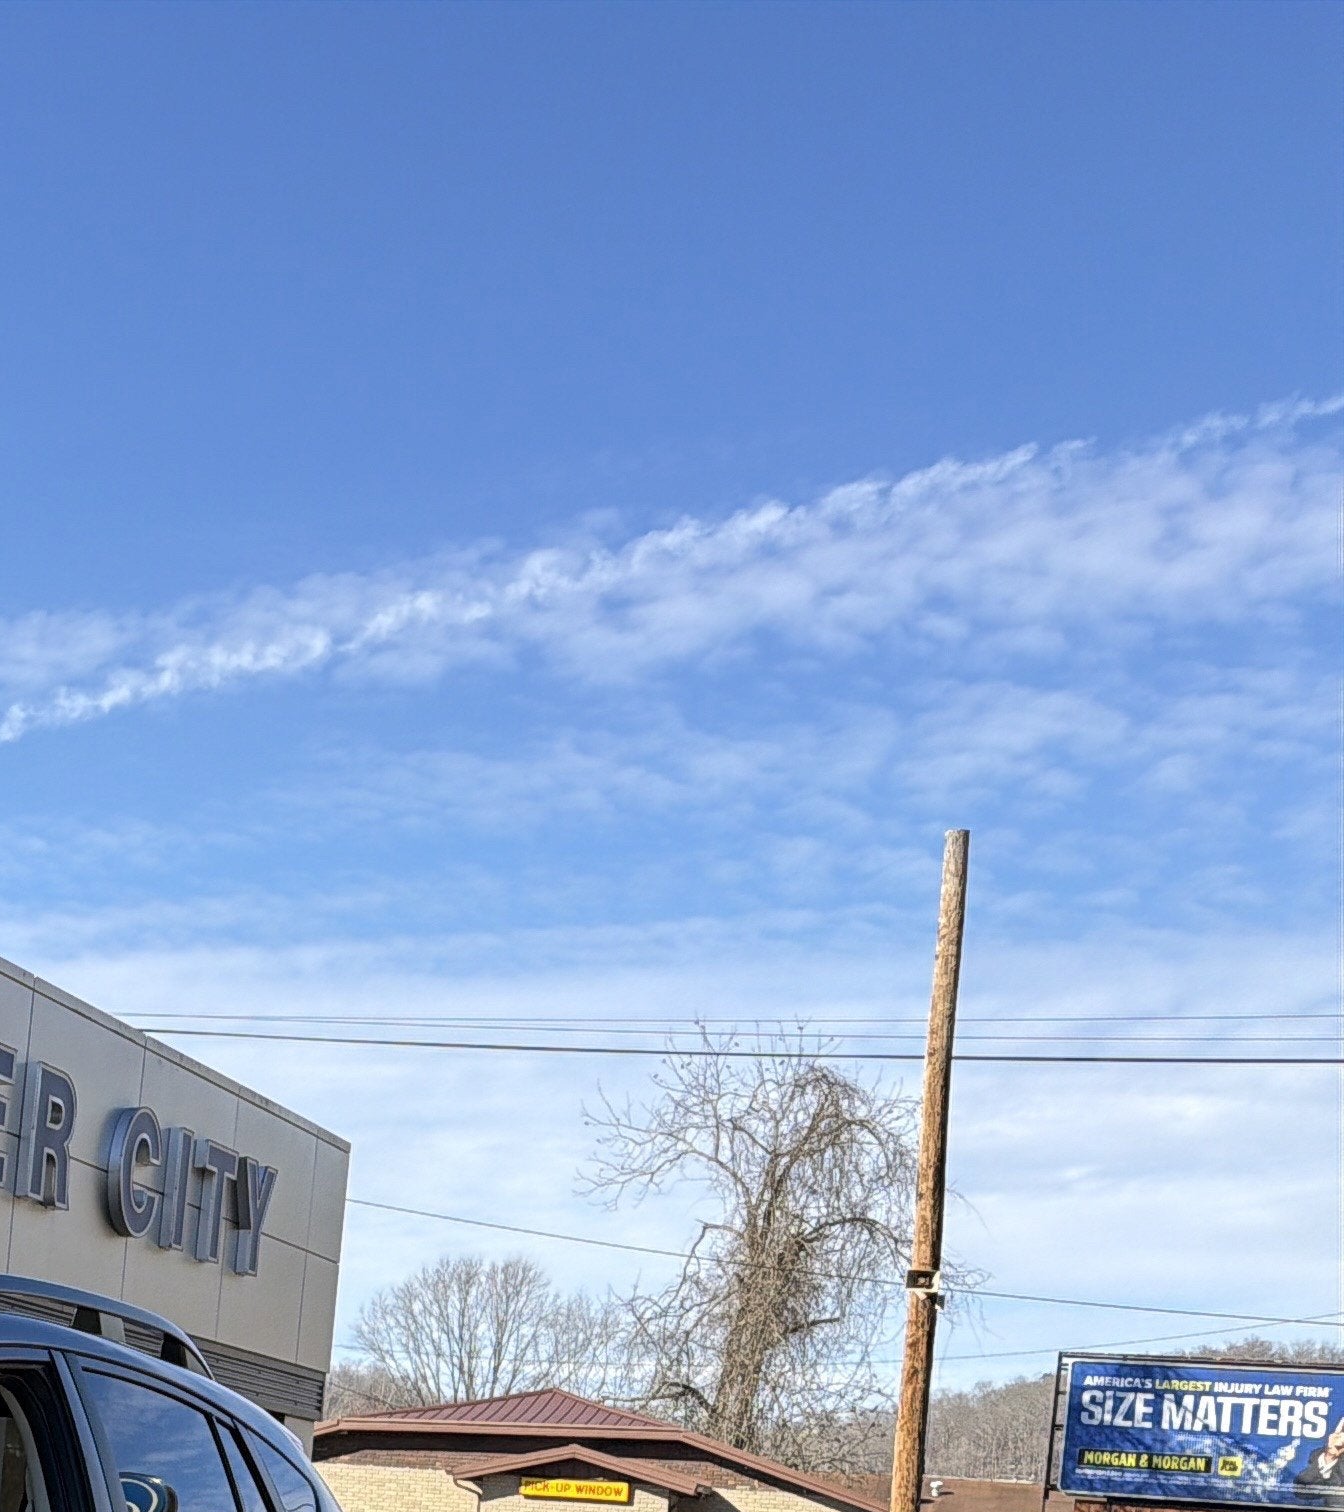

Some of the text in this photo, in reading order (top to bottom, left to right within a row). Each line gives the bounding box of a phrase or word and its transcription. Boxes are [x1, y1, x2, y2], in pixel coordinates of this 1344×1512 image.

[108, 1106, 278, 1276] CITY
[1083, 1375, 1330, 1399] AMERICA'S LARGEST INJURY LAW FIRM
[1081, 1389, 1330, 1439] SIZE MATTERS
[1083, 1451, 1136, 1468] MORGAN
[1139, 1455, 1149, 1468] &
[1152, 1456, 1207, 1472] MORGAN
[524, 1480, 624, 1497] PICK-UP WINDOW
